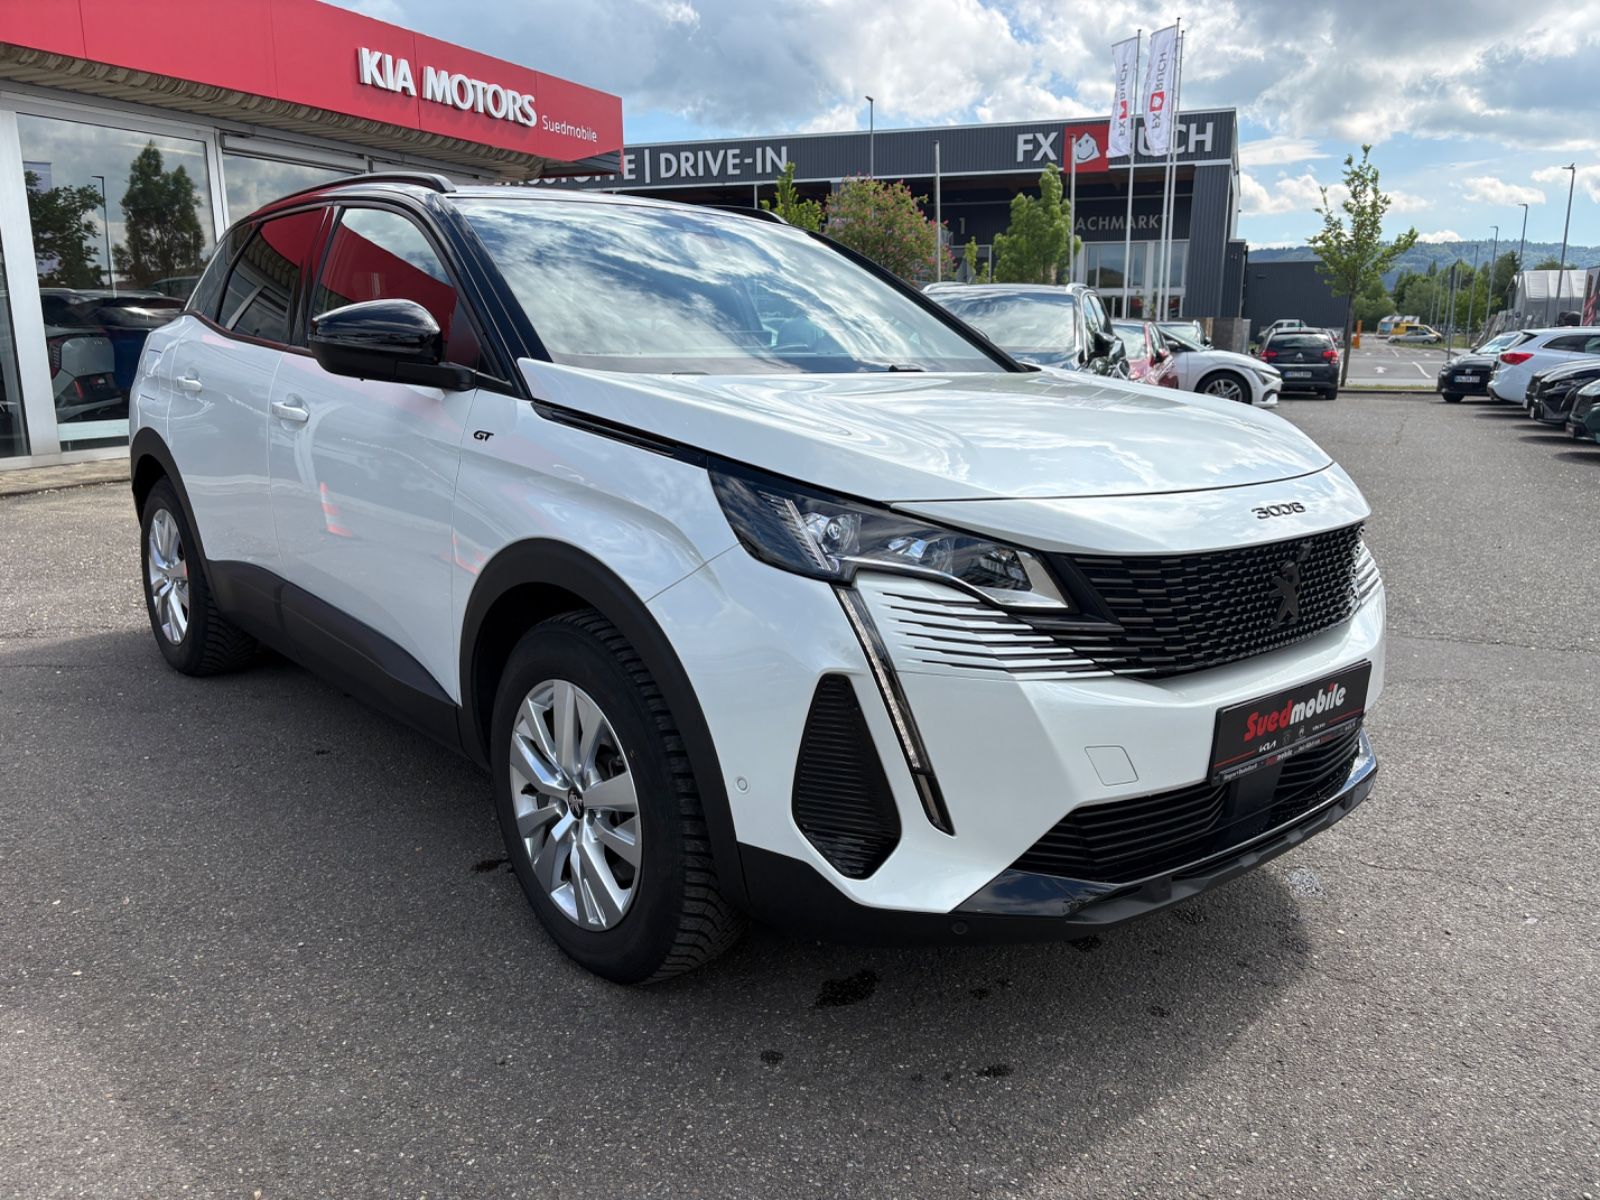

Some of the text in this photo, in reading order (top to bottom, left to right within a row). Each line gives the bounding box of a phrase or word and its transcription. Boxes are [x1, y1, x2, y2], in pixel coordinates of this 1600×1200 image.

[357, 47, 538, 128] KIA MOTORS
[541, 114, 598, 144] Suedmobile
[659, 145, 788, 178] DRIVE-IN
[1016, 131, 1060, 162] FX
[473, 430, 494, 442] GT
[1244, 682, 1346, 743] Suedmobile
